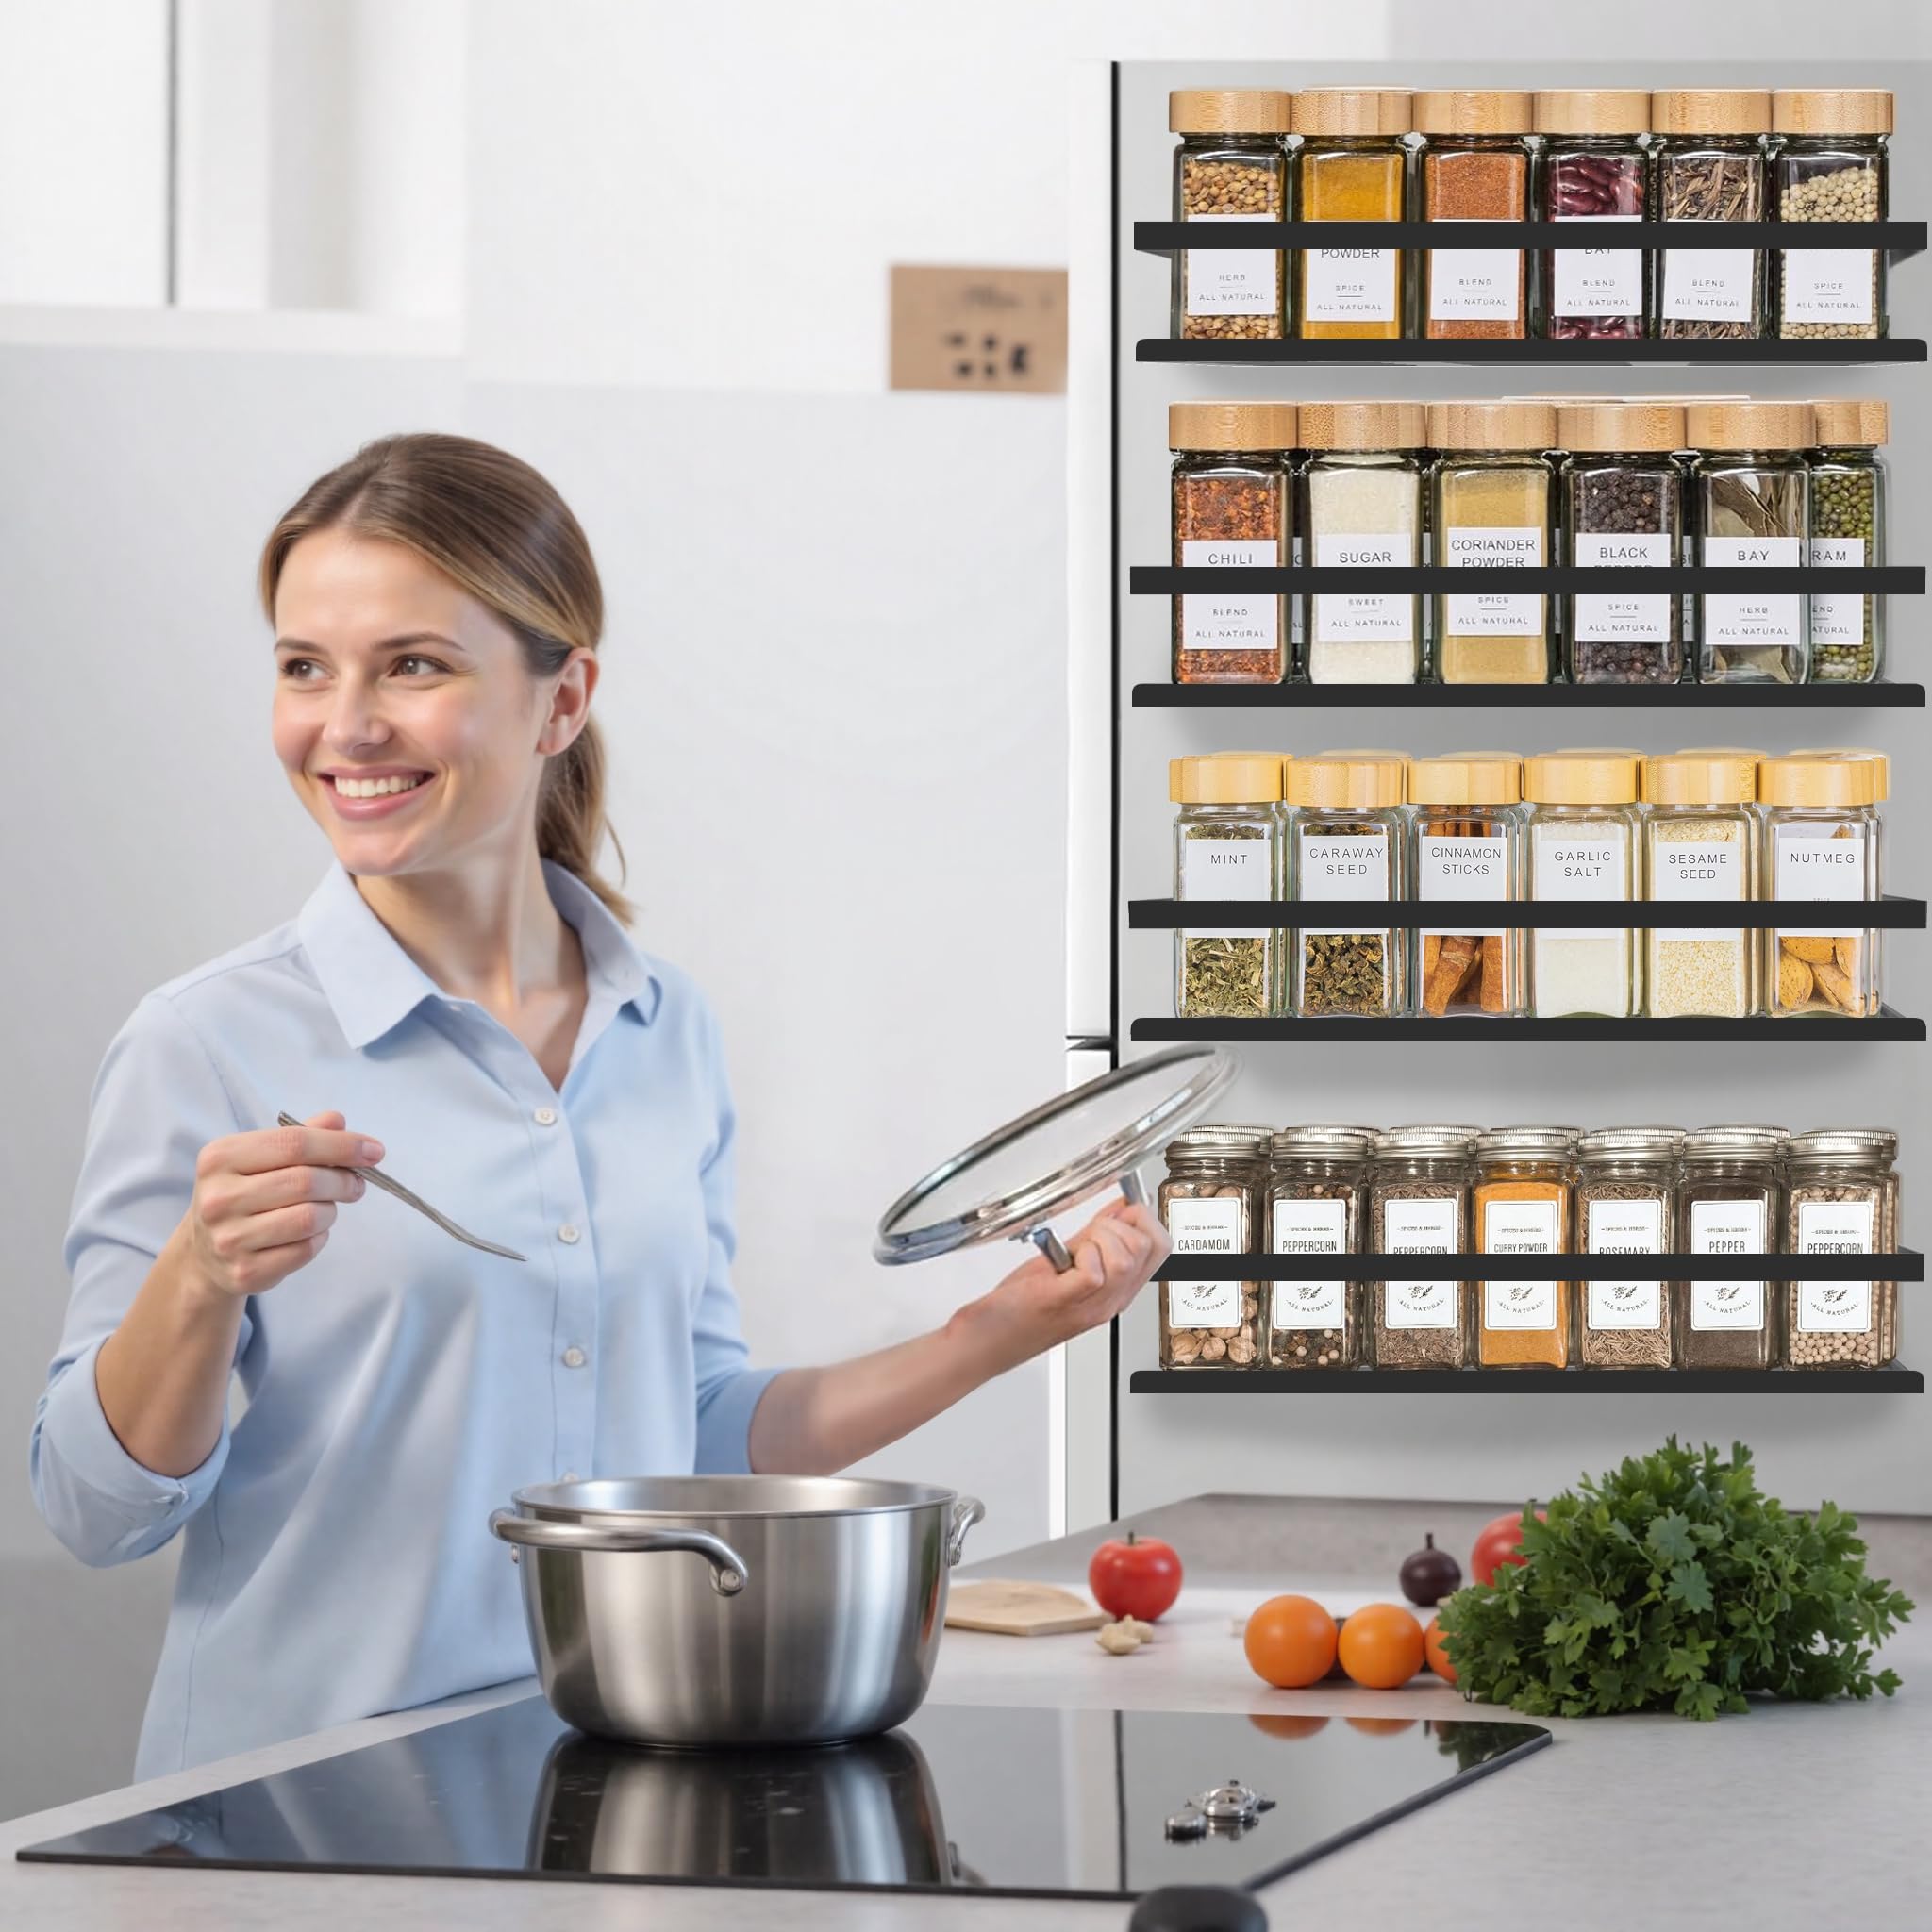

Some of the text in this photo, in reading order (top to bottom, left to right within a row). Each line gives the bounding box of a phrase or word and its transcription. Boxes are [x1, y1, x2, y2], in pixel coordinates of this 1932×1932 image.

[1322, 249, 1379, 258] POWDER
[1452, 540, 1535, 550] CORIANDER
[1340, 552, 1391, 563] SUGAR
[1600, 547, 1647, 558] BLACK
[1738, 551, 1769, 560] BAY
[1208, 553, 1252, 564] CHILI
[1462, 557, 1524, 567] POWDER
[1310, 848, 1383, 858] CARAWAY
[1432, 847, 1501, 858] CINNAMON
[1555, 852, 1610, 861] GARLIC
[1211, 855, 1247, 864] MINT
[1669, 854, 1726, 864] SESAME
[1791, 853, 1854, 863] NUTMEG
[1327, 865, 1367, 874] SEED
[1442, 864, 1489, 874] STICKS
[1564, 867, 1601, 876] SALT
[1680, 870, 1715, 879] SEED
[1178, 1239, 1229, 1251] CARDAMOM
[1283, 1241, 1336, 1252] PEPPERCORN
[1494, 1243, 1547, 1253] CURRY POWDER
[1709, 1241, 1745, 1253] PEPPER
[1808, 1243, 1863, 1254] PEPPERCORN
